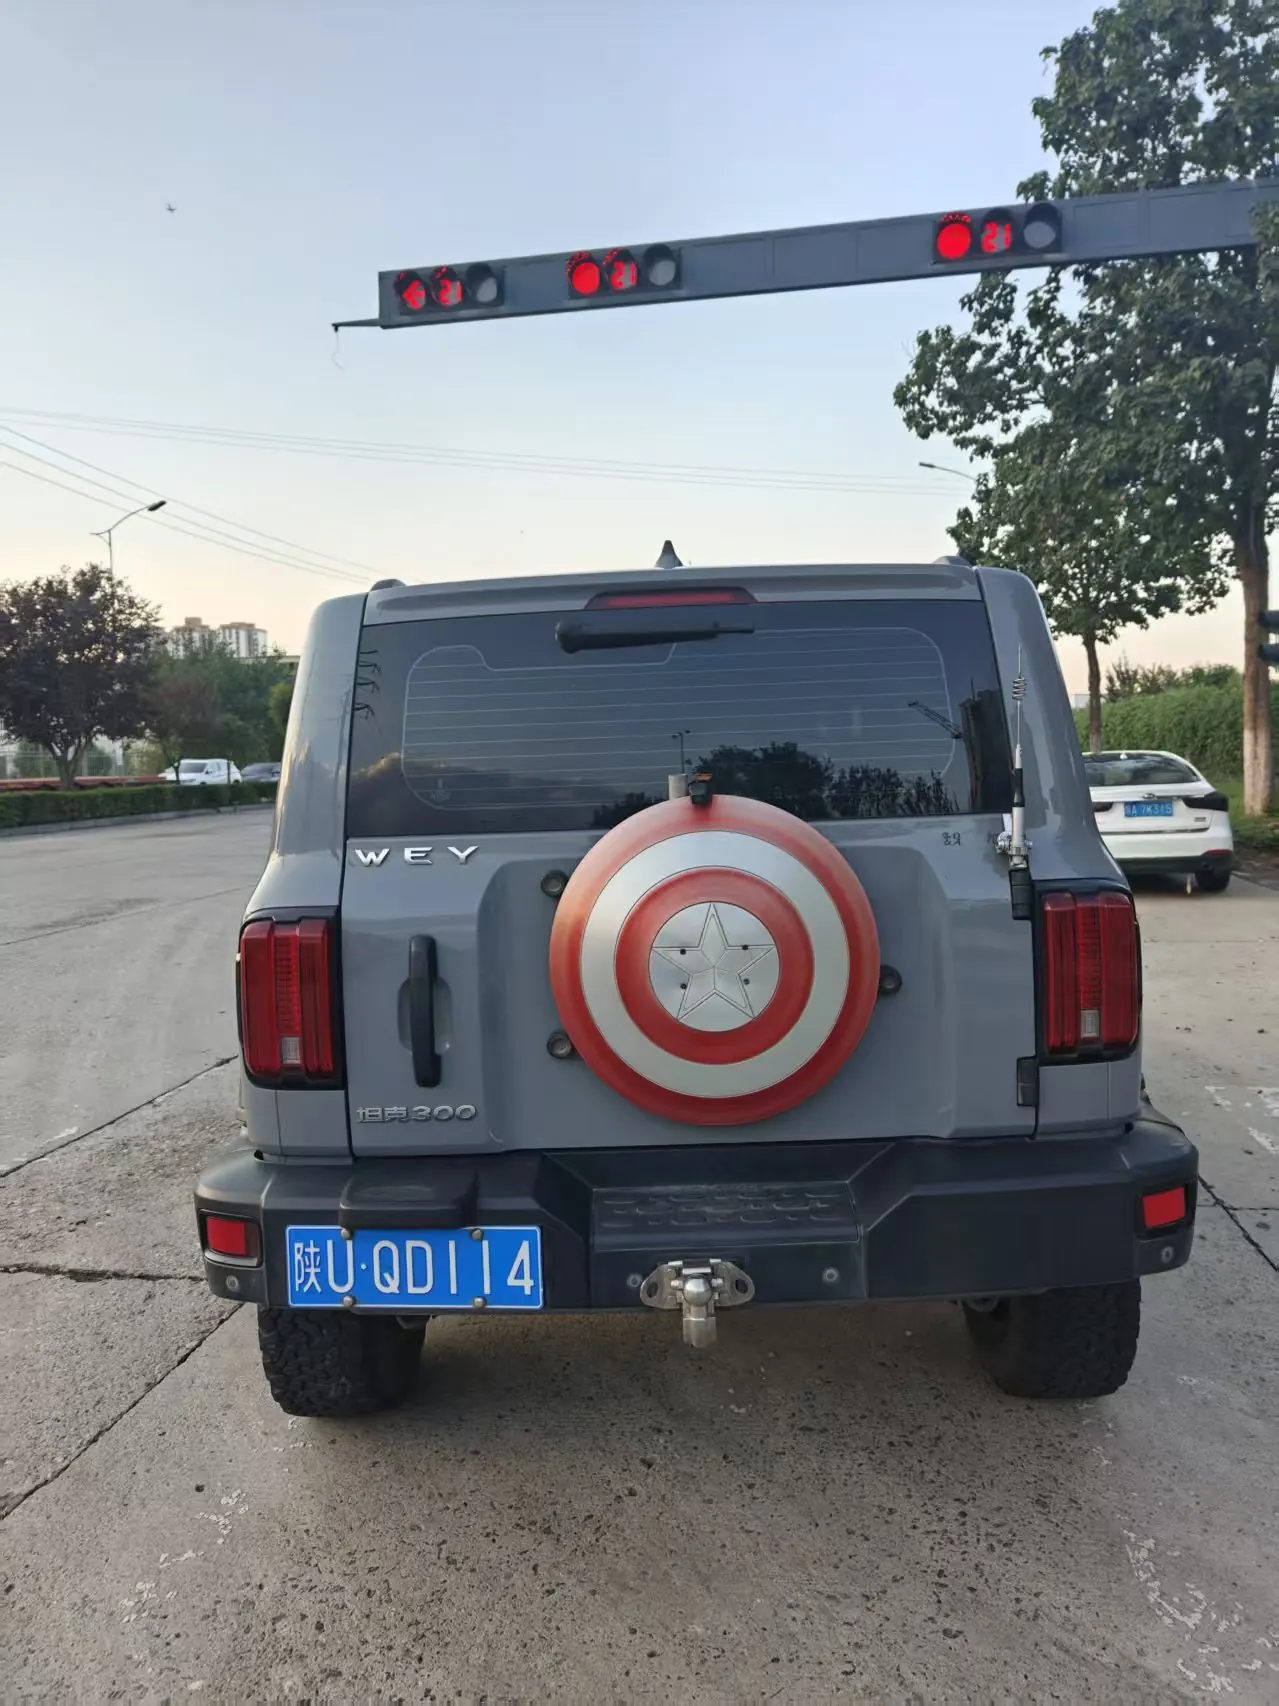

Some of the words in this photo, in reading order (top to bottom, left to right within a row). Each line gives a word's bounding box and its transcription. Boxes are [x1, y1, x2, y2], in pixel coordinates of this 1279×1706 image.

[981, 222, 1012, 253] 21
[611, 261, 637, 289] 21
[439, 279, 463, 305] 21
[355, 845, 479, 867] WEY
[294, 1239, 535, 1295] 陕U·QD114
